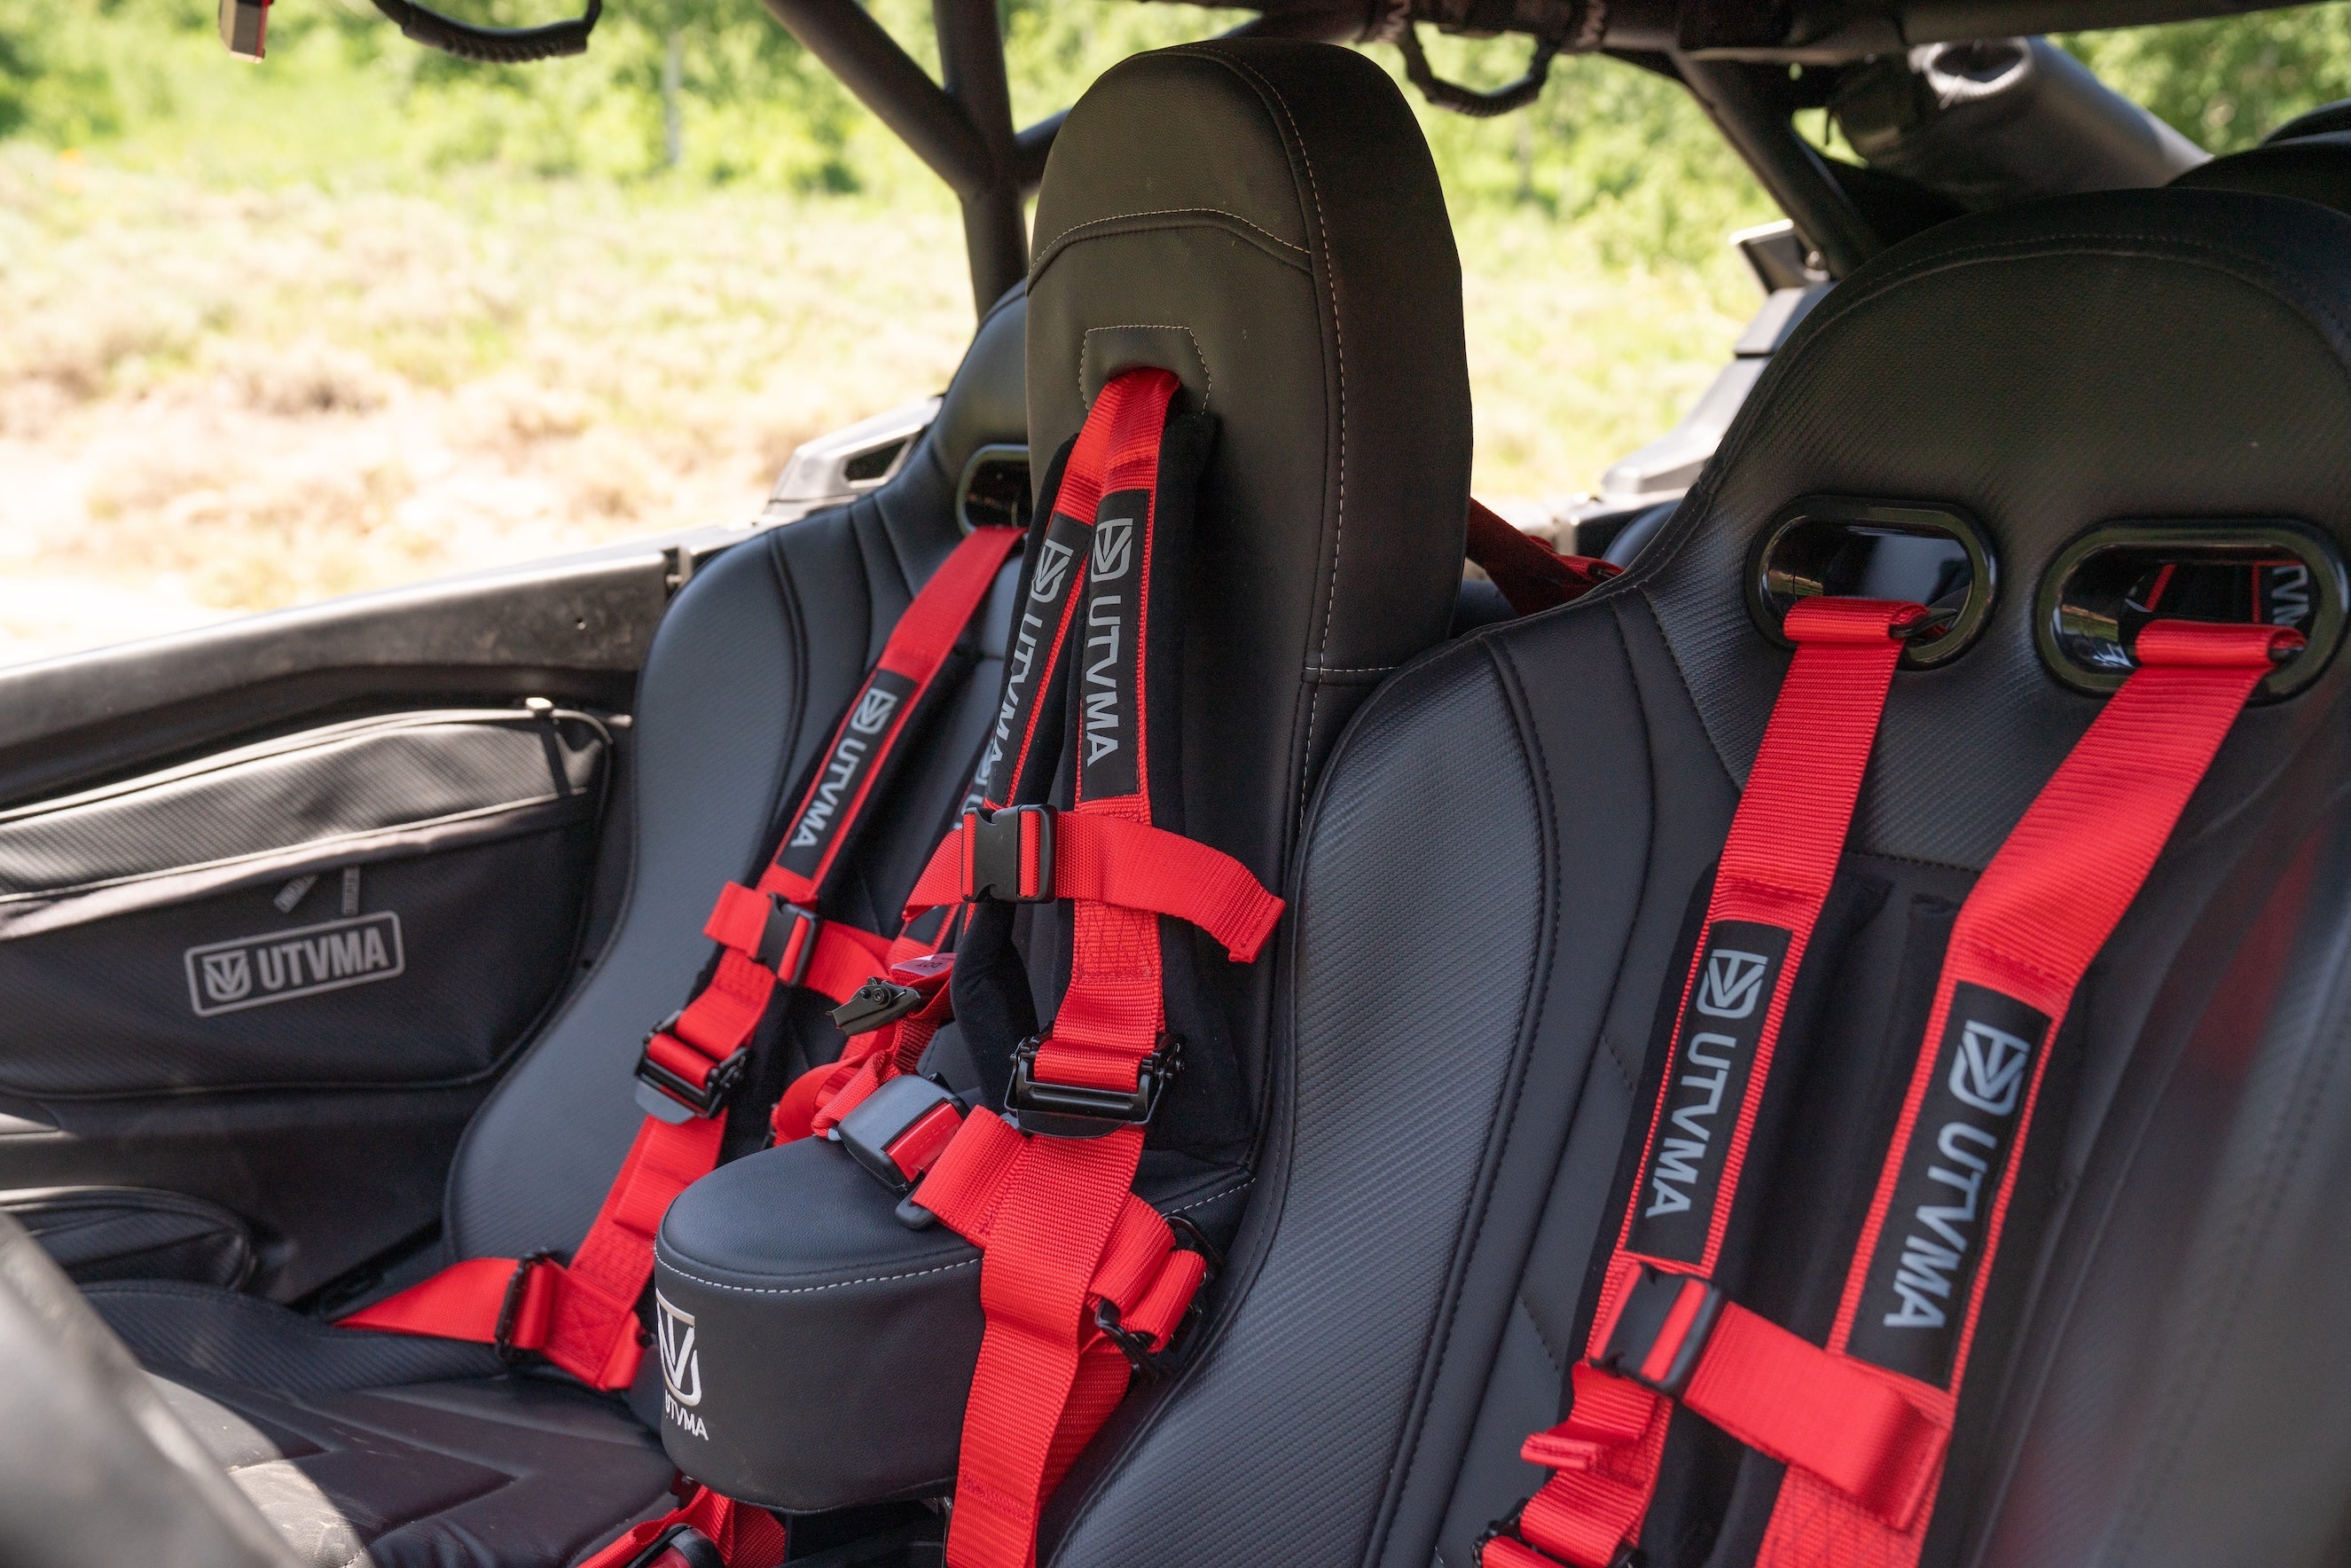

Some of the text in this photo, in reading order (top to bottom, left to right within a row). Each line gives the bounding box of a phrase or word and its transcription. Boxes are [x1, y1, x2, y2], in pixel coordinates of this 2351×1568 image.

[1085, 595, 1122, 767] UTVMA
[791, 738, 867, 847] UTVMA
[256, 927, 389, 992] UTVMA
[1645, 1029, 1736, 1219] UTVMA
[1884, 1121, 1996, 1329] UTVMA
[664, 1389, 709, 1441] UTVMA
